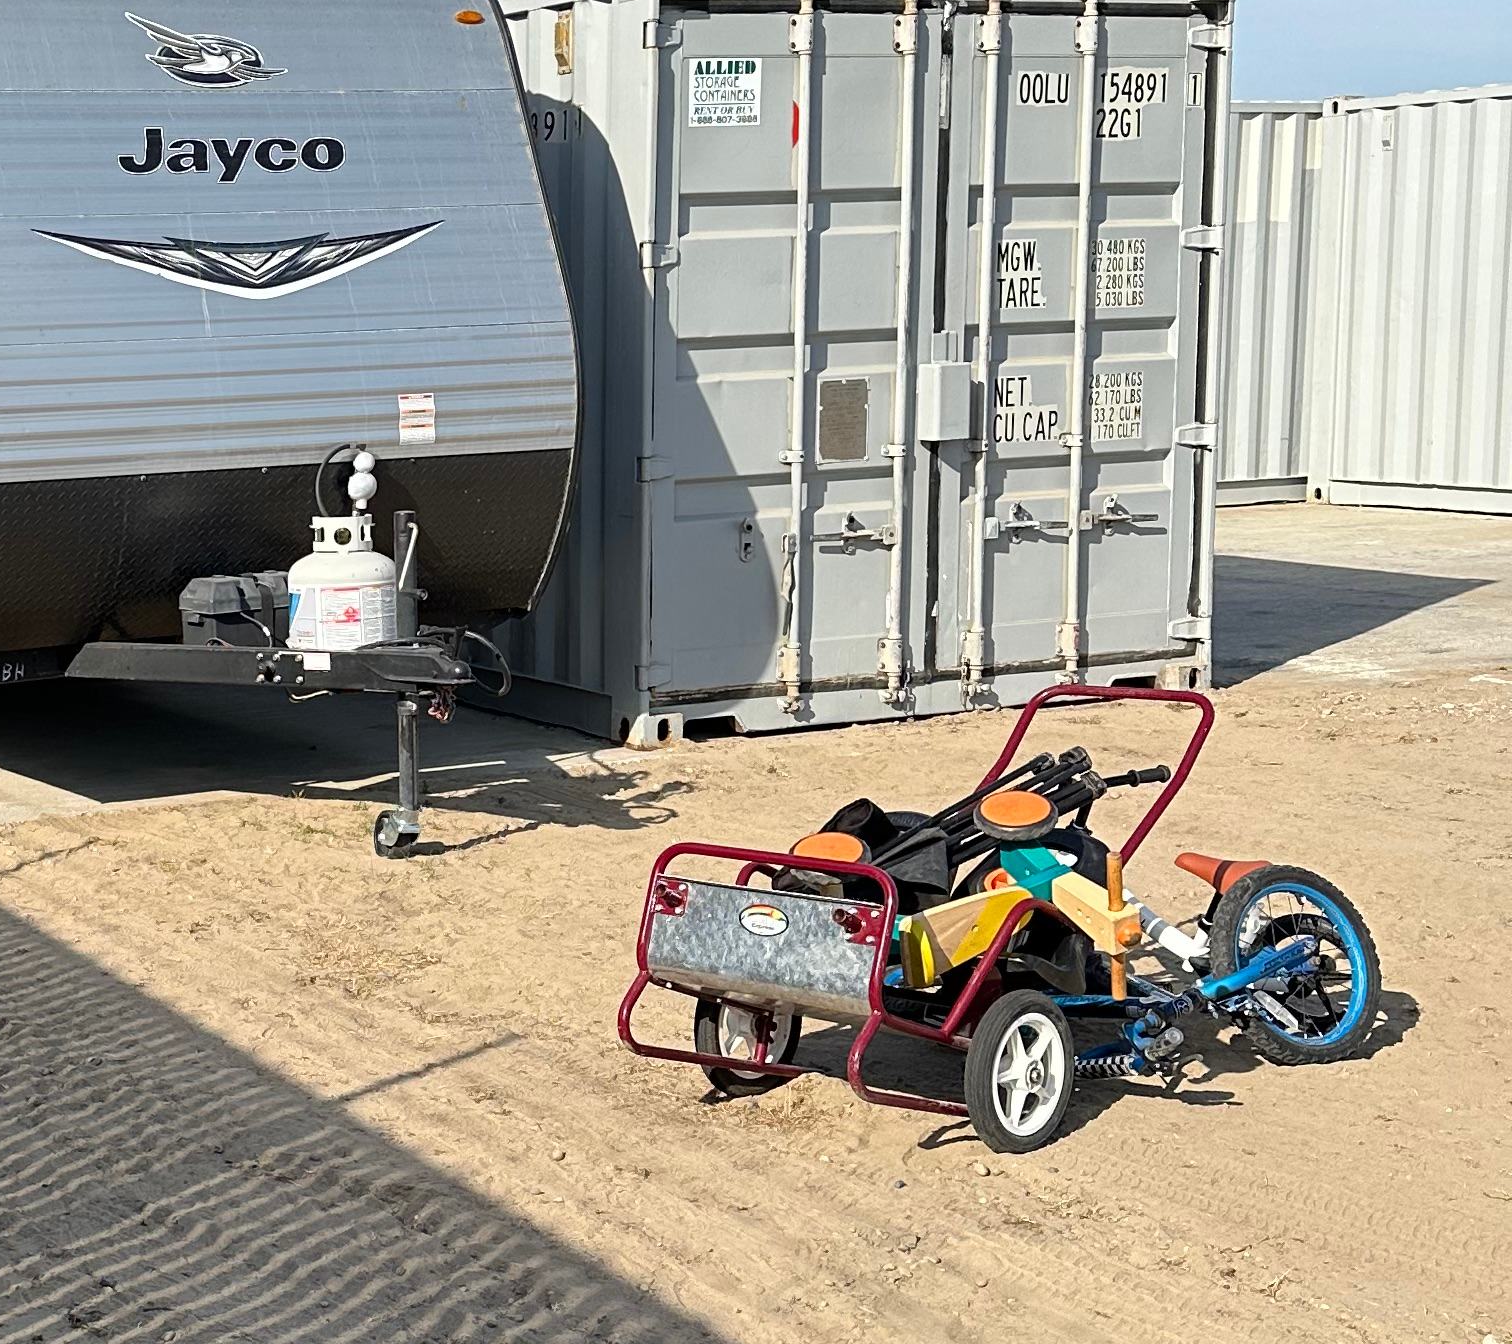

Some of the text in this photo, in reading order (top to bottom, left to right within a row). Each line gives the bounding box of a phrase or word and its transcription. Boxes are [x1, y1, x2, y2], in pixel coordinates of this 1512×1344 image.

[694, 60, 757, 75] ALLIED
[693, 76, 740, 88] STORAGE
[1019, 72, 1198, 105] OOLU 154891 1
[693, 89, 756, 102] CONTAINERS
[694, 105, 753, 115] RENT OR BUY
[1096, 108, 1141, 138] 22G1
[118, 126, 346, 184] Jayco
[1127, 239, 1146, 254] KGS
[997, 241, 1042, 272] MGW.
[1127, 256, 1145, 272] LBS
[1126, 274, 1144, 289] KGS
[997, 277, 1046, 309] TARE.
[1126, 290, 1144, 306] LBS
[1125, 372, 1143, 387] KGS
[1124, 389, 1142, 404] LBS
